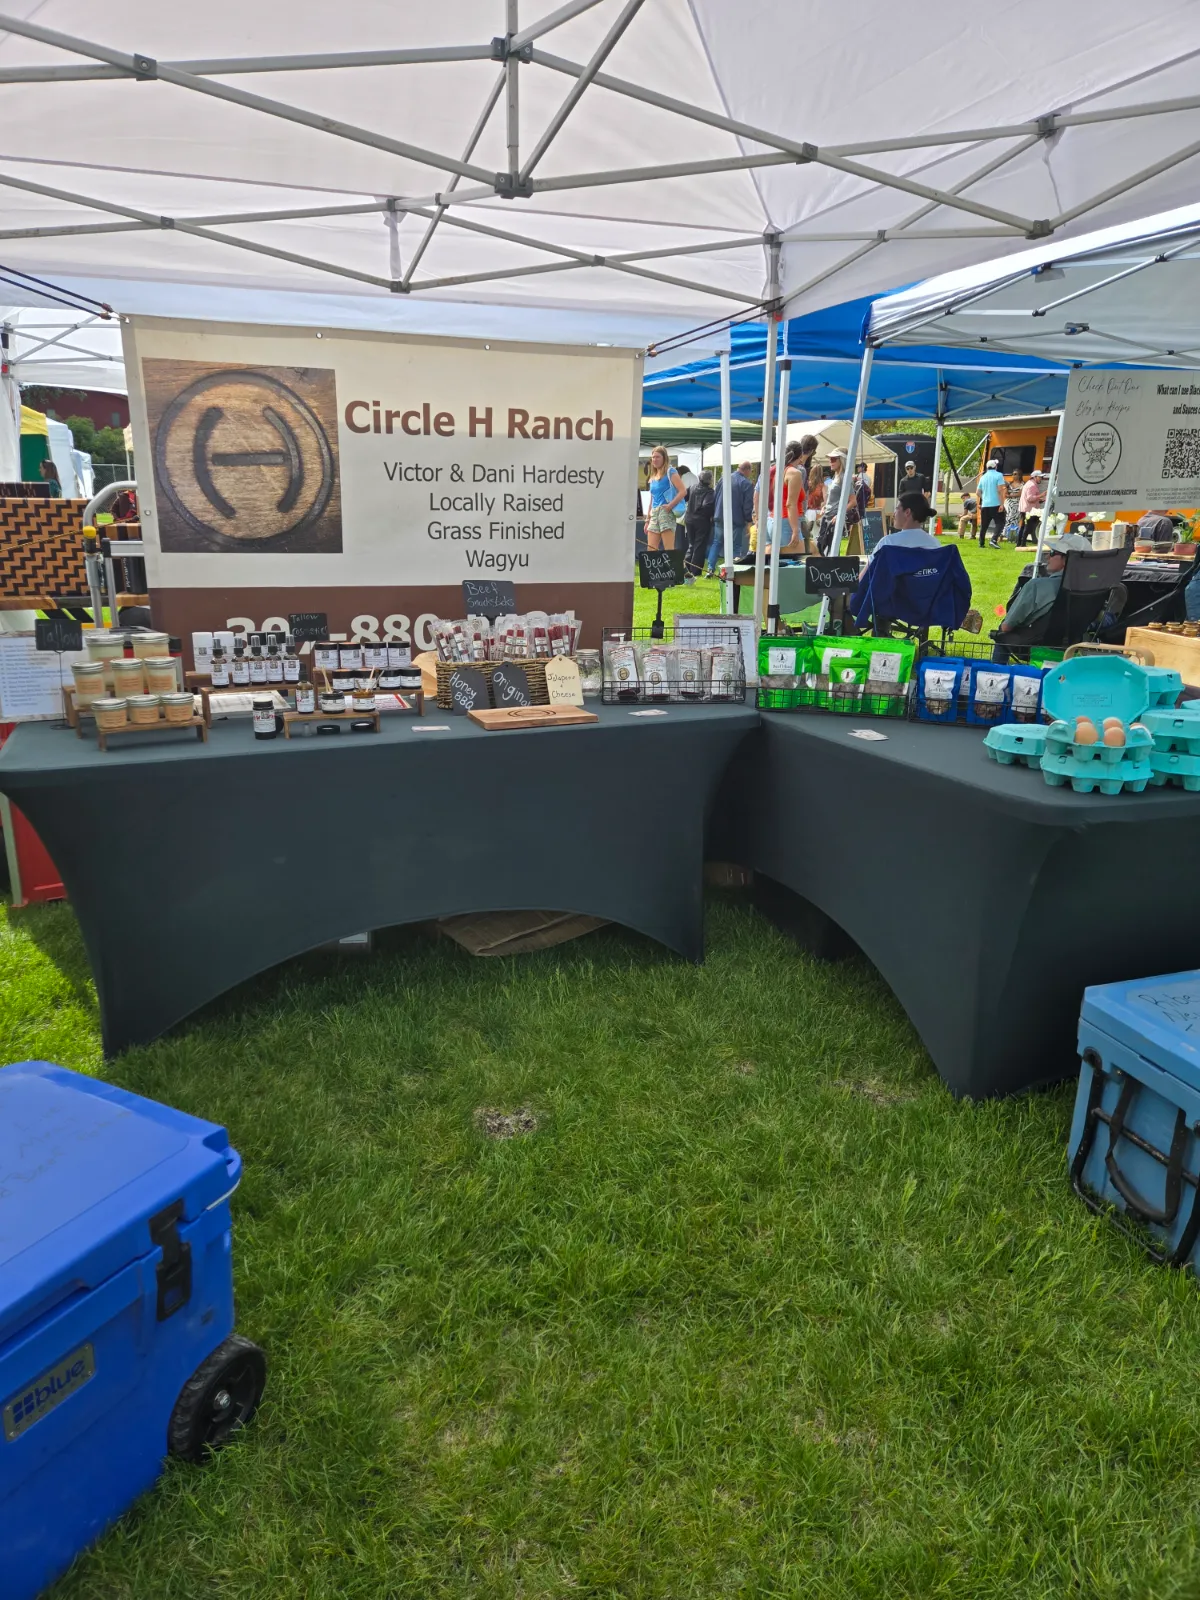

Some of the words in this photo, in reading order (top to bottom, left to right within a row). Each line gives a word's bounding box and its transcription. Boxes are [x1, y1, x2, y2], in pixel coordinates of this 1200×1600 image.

[344, 400, 455, 437] Circle
[468, 406, 493, 438] H
[507, 407, 614, 441] Ranch
[384, 462, 443, 482] Victor
[450, 463, 465, 483] &
[472, 464, 515, 483] Dani
[523, 465, 605, 488] Hardesty
[429, 493, 496, 516] Locally
[503, 493, 564, 512] Raised
[427, 522, 482, 540] Grass
[489, 522, 565, 540] Finished
[465, 550, 530, 572] Wagyu
[642, 553, 671, 568] Beef
[464, 581, 499, 595] Beef
[809, 566, 831, 588] Dog
[830, 567, 859, 582] Treats
[290, 614, 319, 624] Tallow
[37, 623, 82, 649] Tallow
[449, 671, 477, 699] Honey
[551, 691, 576, 699] Cheese
[454, 691, 474, 711] BBQ
[34, 1360, 84, 1407] blue
